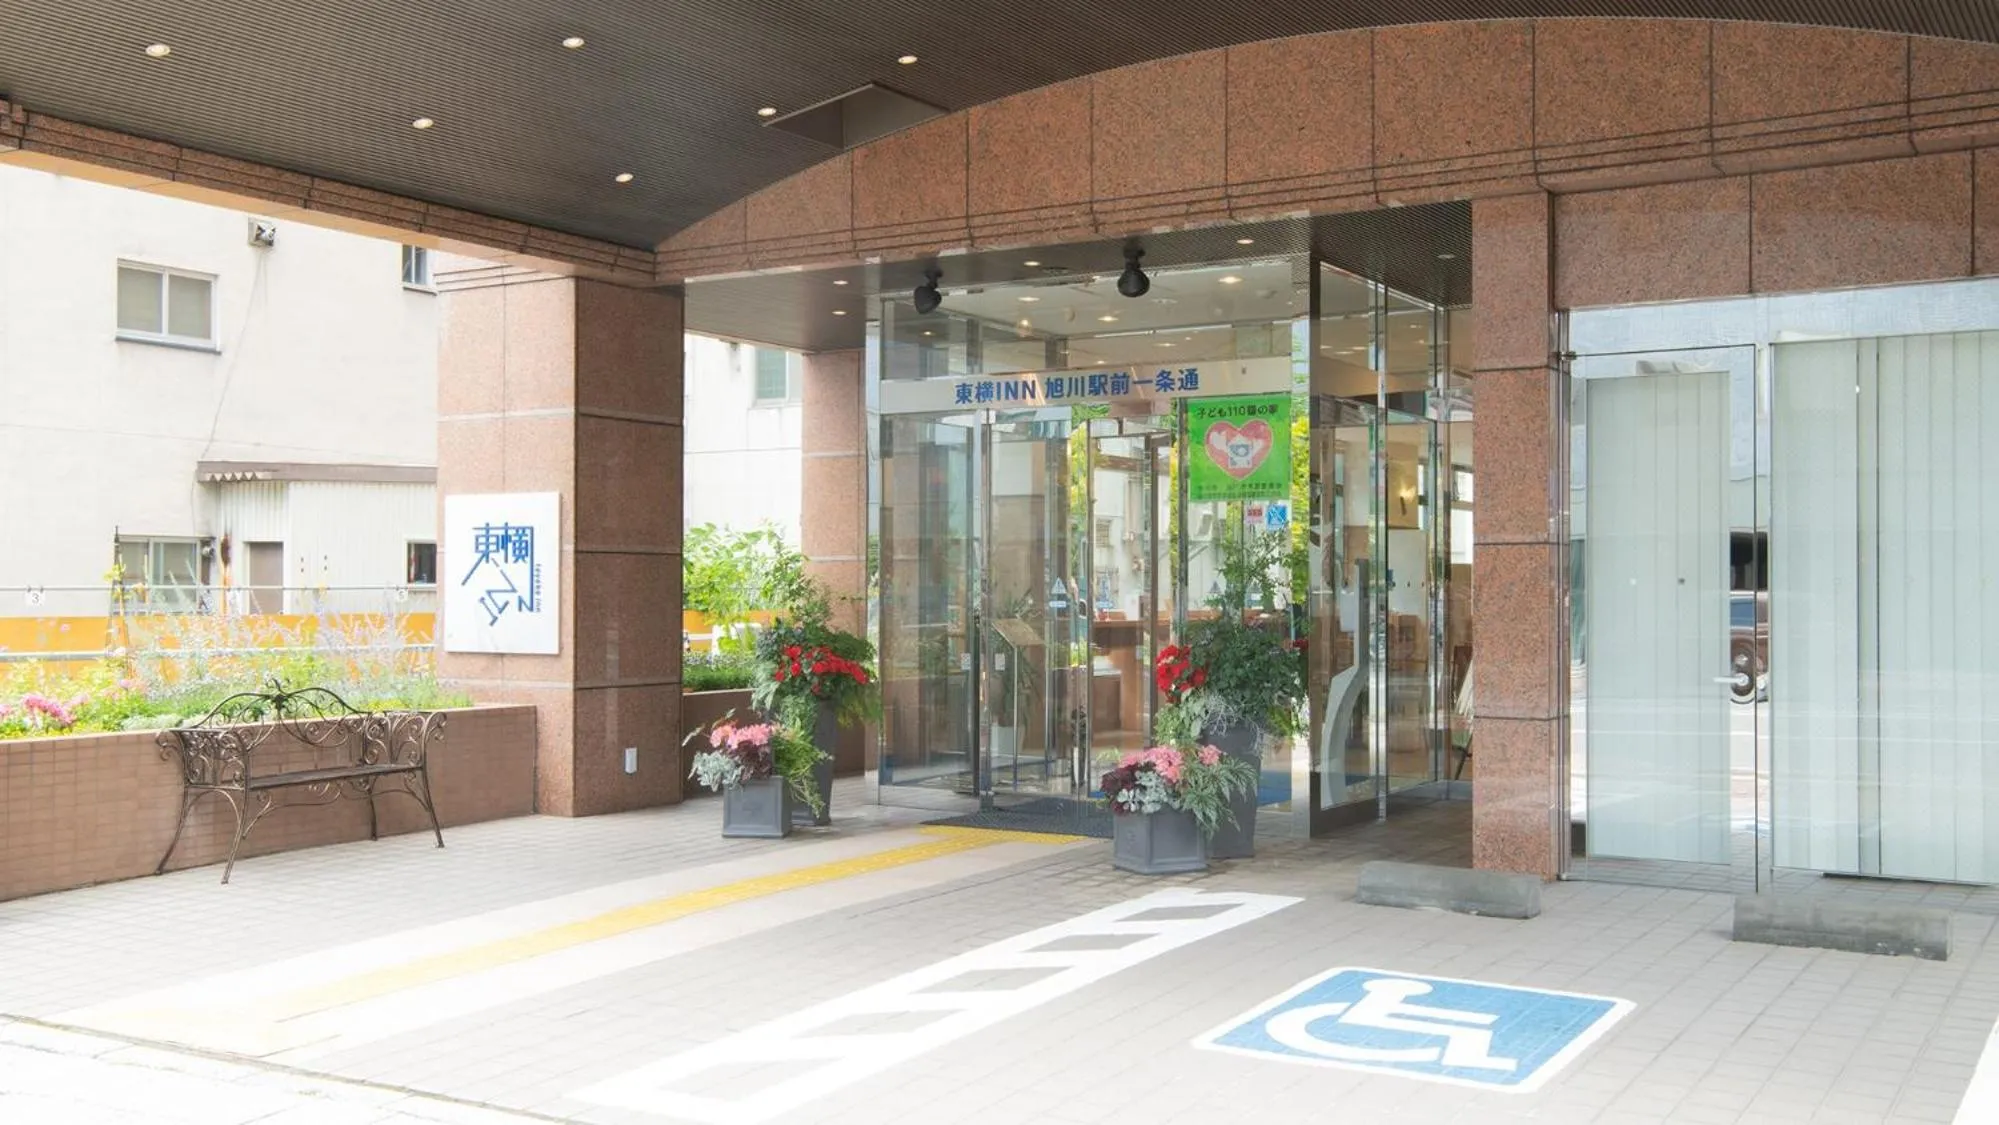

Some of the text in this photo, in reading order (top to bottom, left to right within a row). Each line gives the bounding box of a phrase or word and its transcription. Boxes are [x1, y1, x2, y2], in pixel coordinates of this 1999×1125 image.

[955, 368, 1200, 404] 東横INN 旭川駅前一条通
[31, 592, 40, 604] 3
